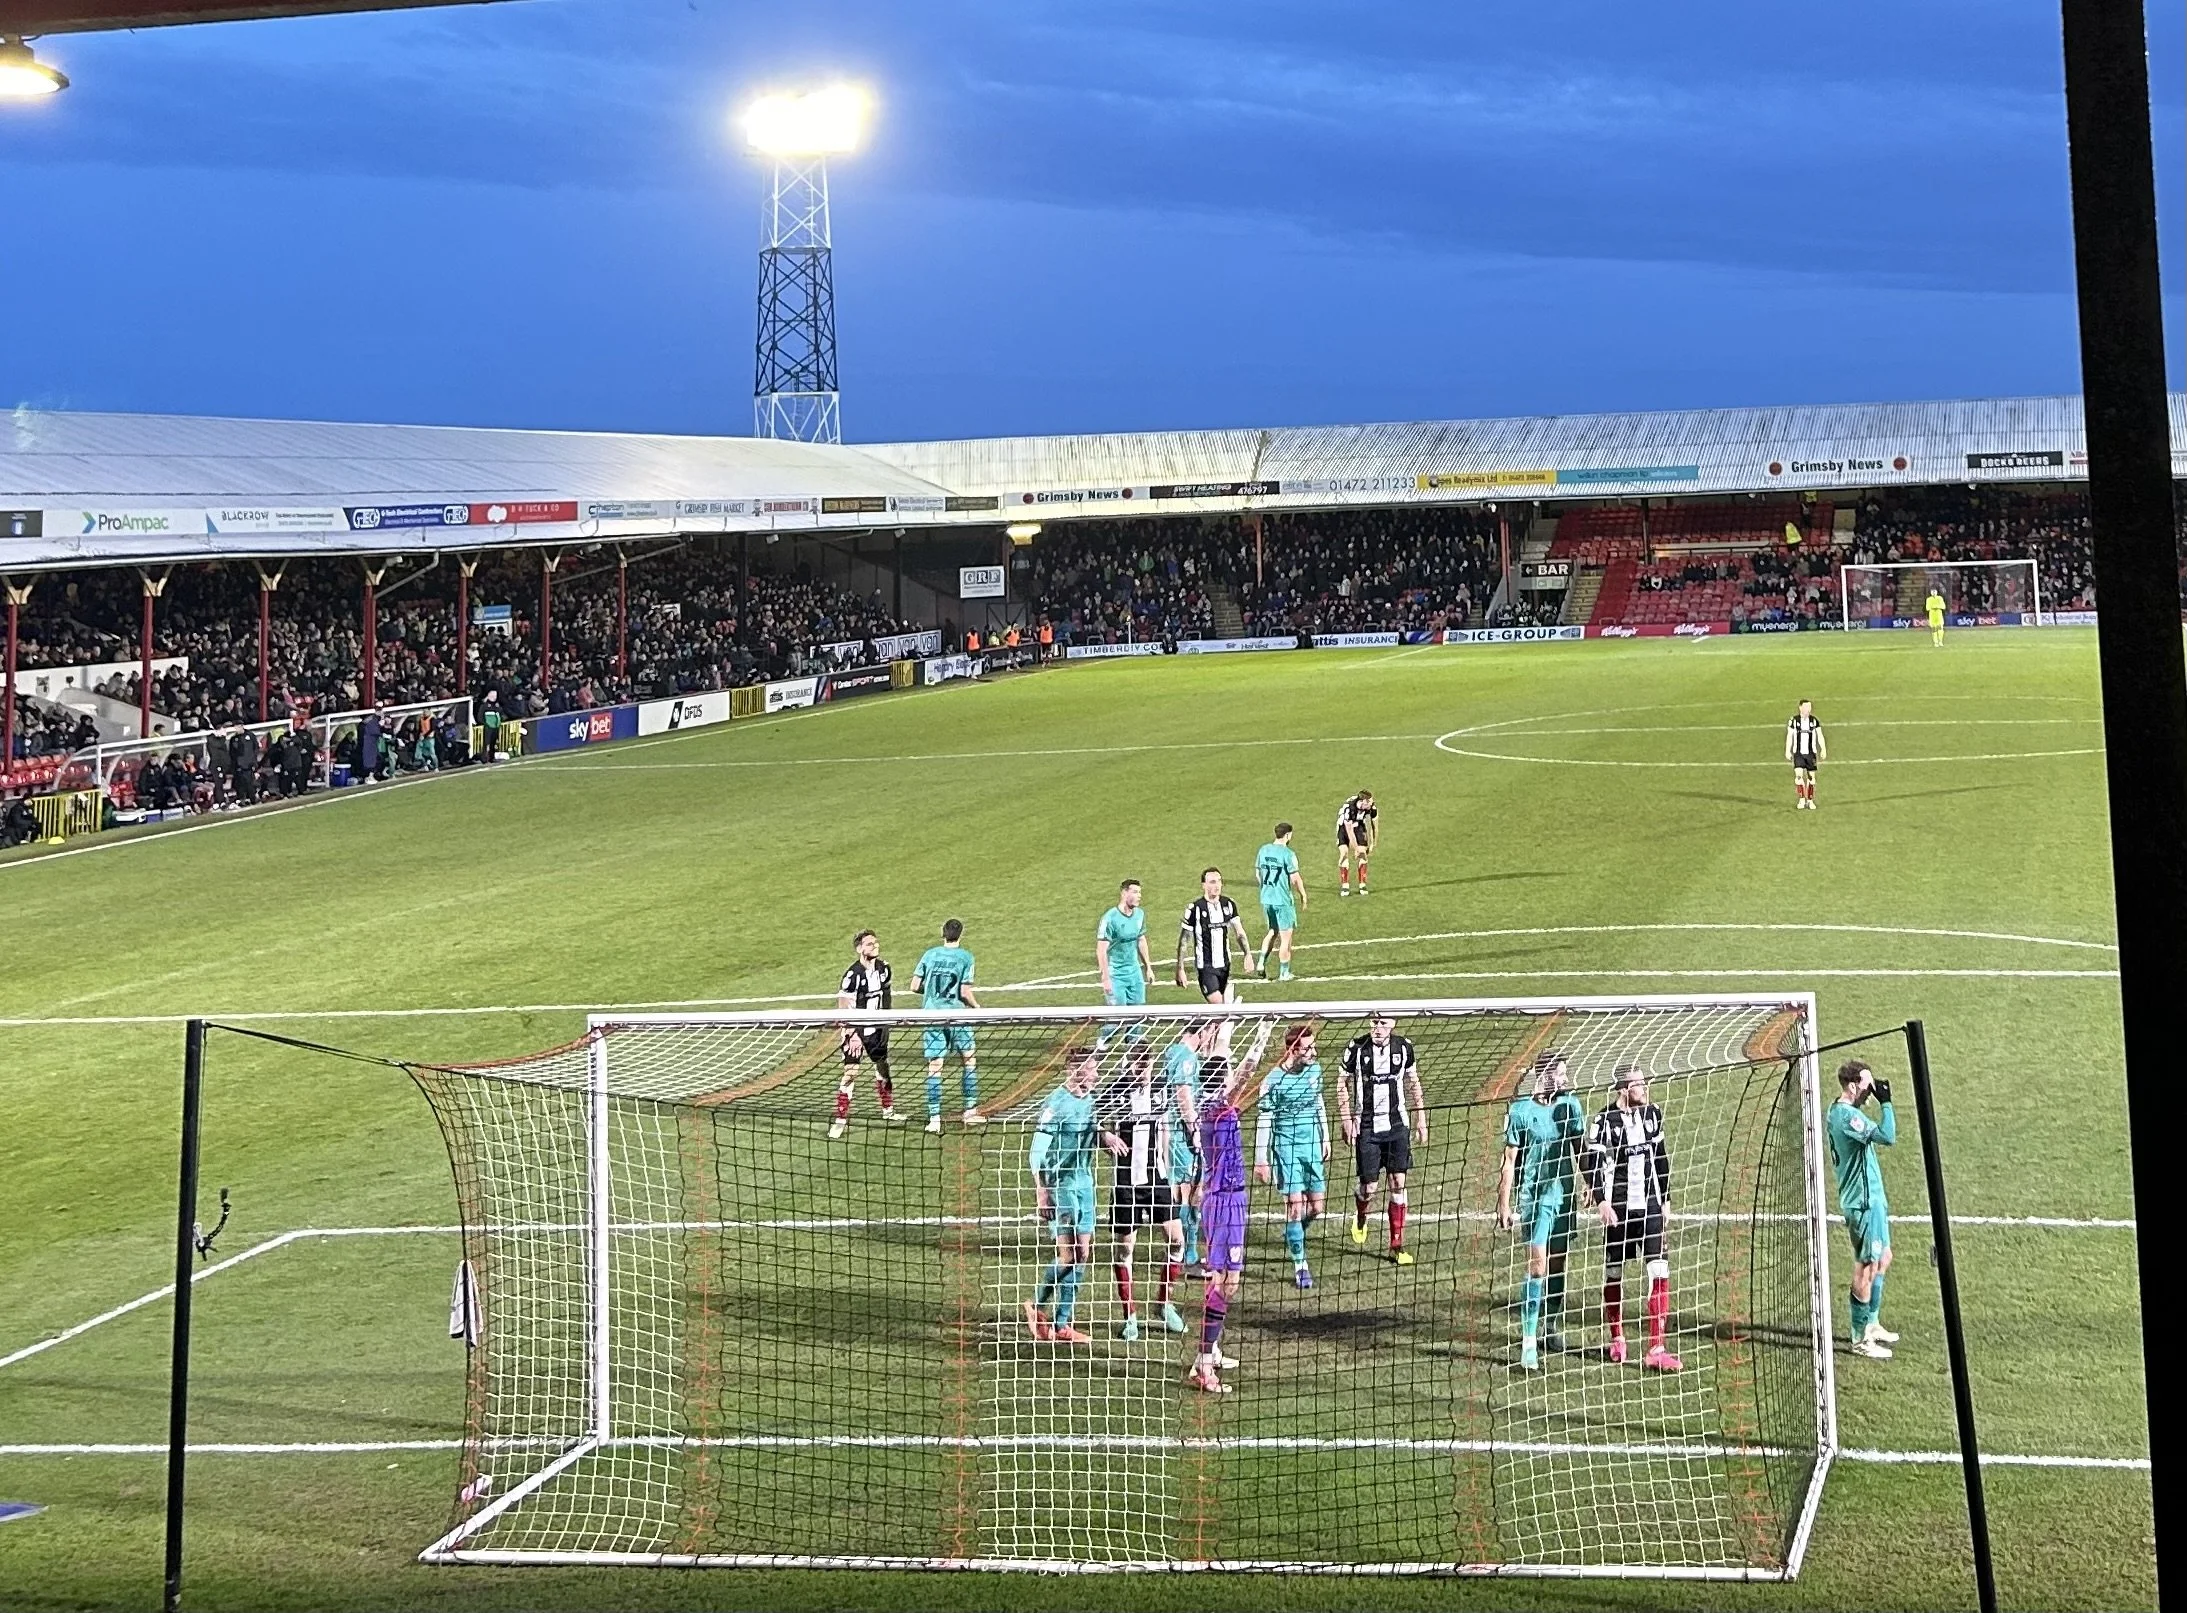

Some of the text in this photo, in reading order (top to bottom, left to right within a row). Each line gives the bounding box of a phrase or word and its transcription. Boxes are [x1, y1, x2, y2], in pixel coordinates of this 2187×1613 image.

[1791, 458, 1884, 473] Grimsby News
[1329, 479, 1367, 491] 01472
[1372, 477, 1416, 490] 211233
[1487, 473, 1498, 483] Ltd
[1037, 489, 1119, 502] Grimsby News
[98, 513, 169, 532] ProAmpac
[1537, 564, 1569, 575] BAR
[1752, 621, 1799, 632] myenergi
[1820, 620, 1866, 631] myeergi
[1892, 617, 1930, 629] sky be
[1957, 616, 1997, 628] sky bet
[1471, 629, 1557, 641] ICE-GROUP
[569, 714, 612, 742] sky bet
